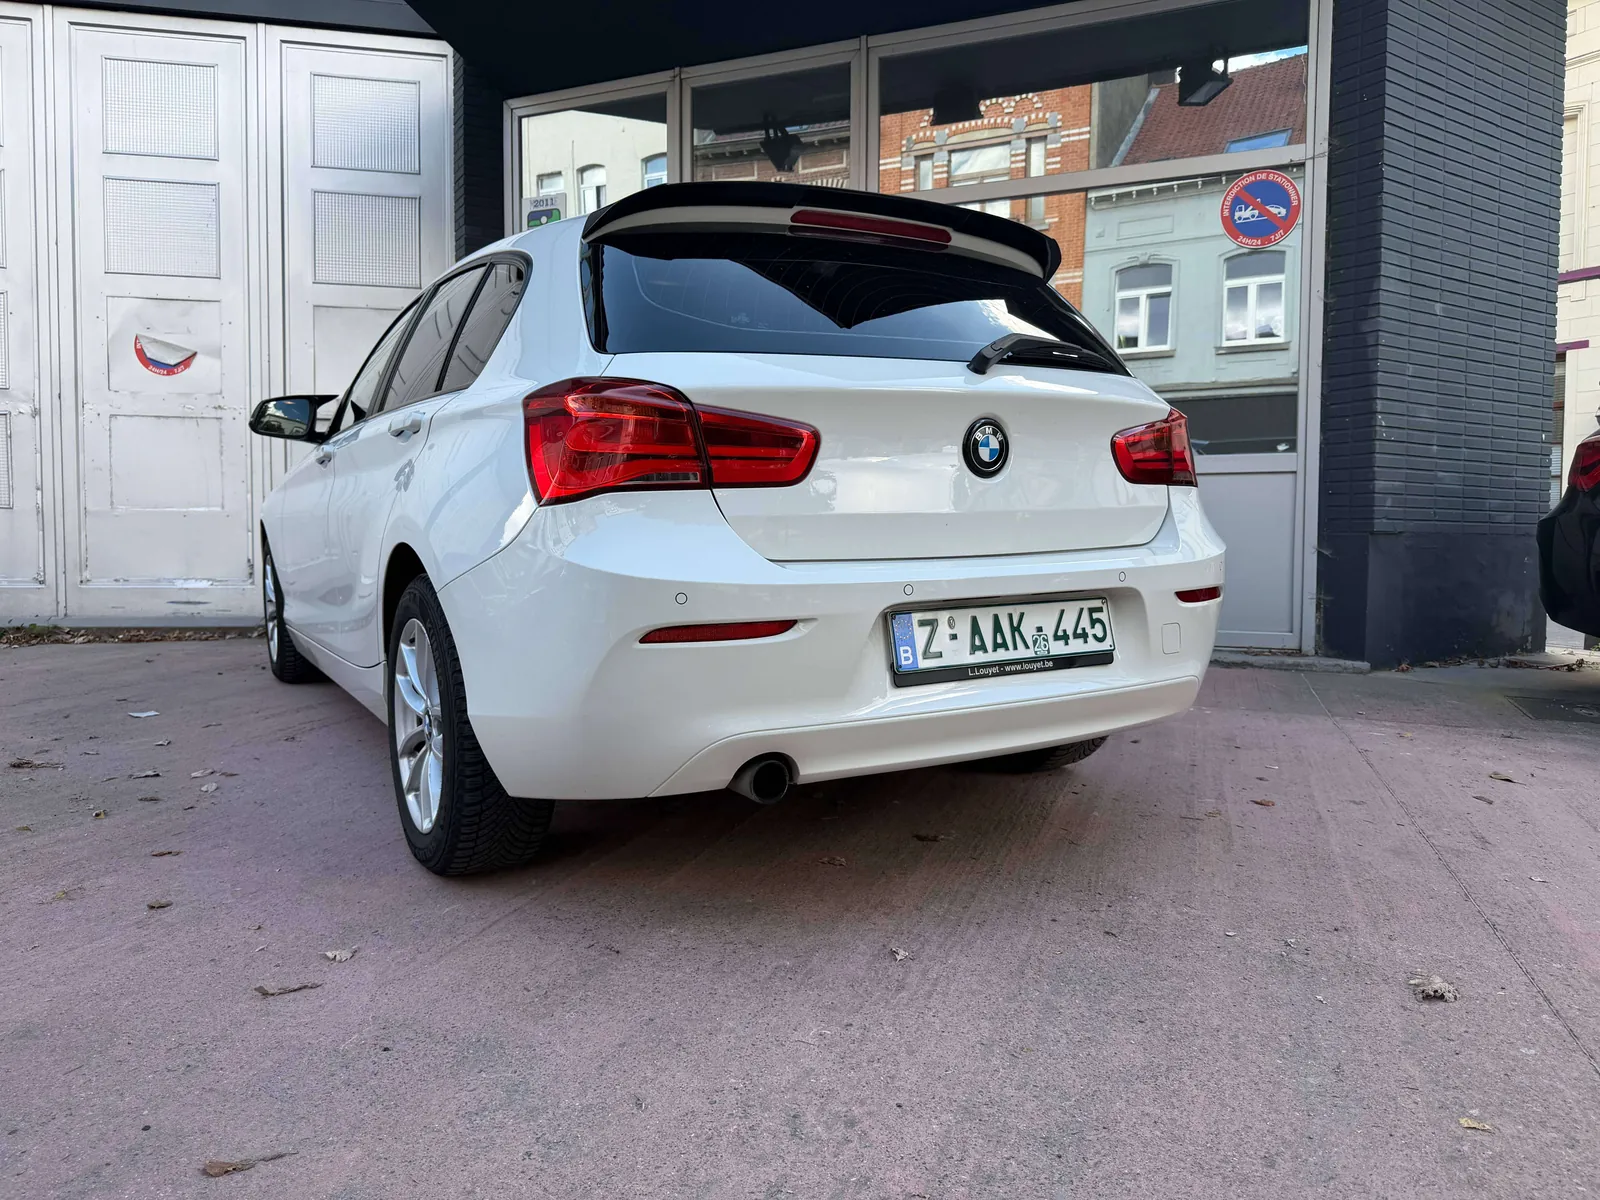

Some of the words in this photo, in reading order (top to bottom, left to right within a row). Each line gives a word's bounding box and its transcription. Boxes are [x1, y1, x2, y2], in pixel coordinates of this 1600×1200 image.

[533, 198, 554, 208] 2011
[1223, 175, 1255, 217] INTERDICTION
[1268, 173, 1298, 206] STATIONNER
[1237, 235, 1261, 245] 24H/24
[975, 427, 1003, 441] BMW
[1033, 635, 1048, 651] 26
[900, 646, 913, 665] B
[968, 666, 999, 676] L.Louyet
[1004, 660, 1053, 672] www.louyet.be
